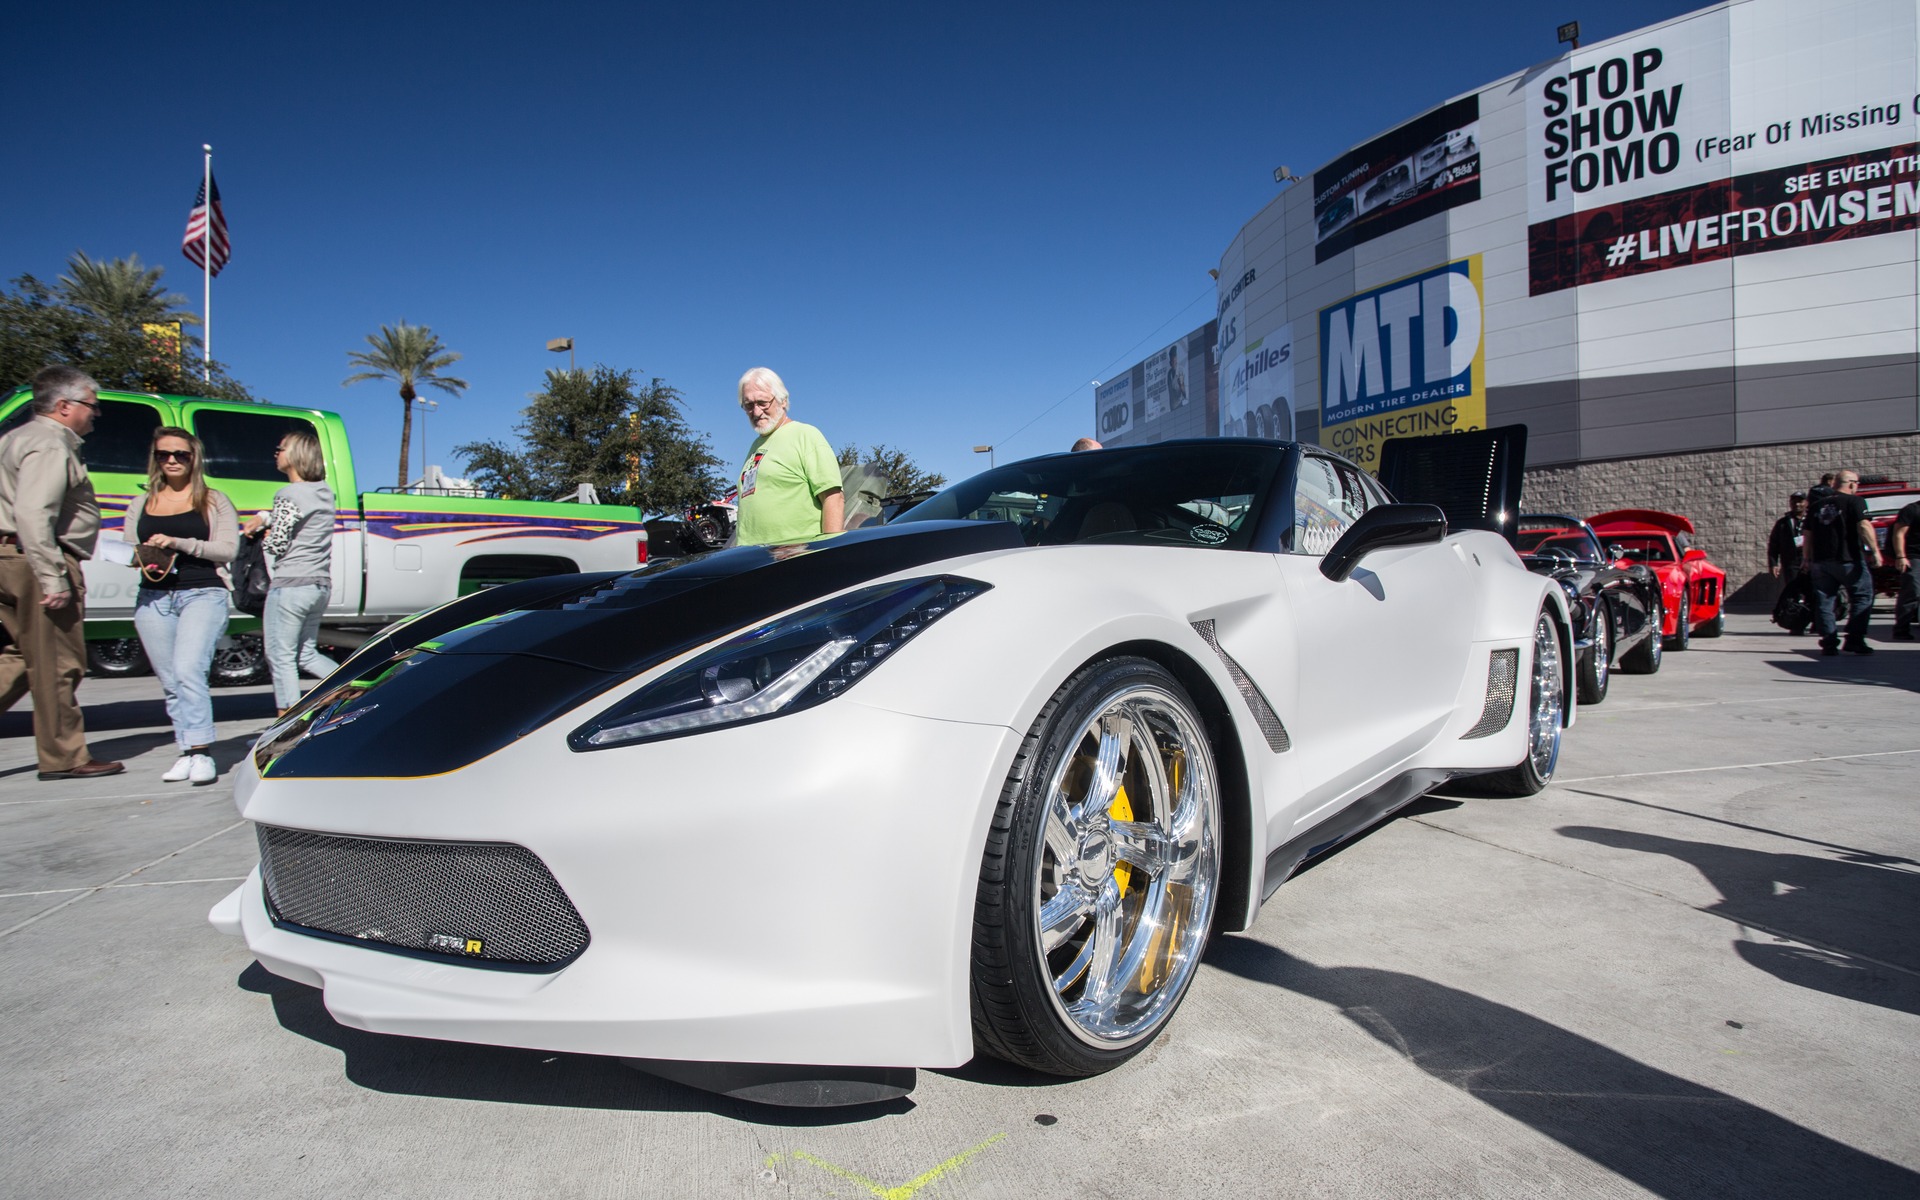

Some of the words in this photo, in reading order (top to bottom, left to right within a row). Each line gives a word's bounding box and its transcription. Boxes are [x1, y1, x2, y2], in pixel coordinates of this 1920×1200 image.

[1543, 47, 1664, 118] STOP
[1544, 83, 1684, 160] SHOW
[1695, 130, 1756, 163] (Fear
[1765, 120, 1792, 145] Of
[1801, 102, 1901, 138] Missing
[1314, 181, 1340, 206] CUSTOM
[1341, 163, 1370, 187] TUNING
[1545, 131, 1681, 203] FOMO
[1784, 172, 1821, 195] SEE
[1605, 181, 1920, 267] #LIVEFROMSEM
[1231, 268, 1256, 302] CENTER
[1326, 271, 1482, 409] MTD
[1232, 343, 1291, 394] Achilles
[1327, 403, 1374, 422] MODERN
[1380, 396, 1406, 409] TIRE
[1412, 383, 1465, 402] DEALER
[1333, 406, 1459, 448] CONNECTING
